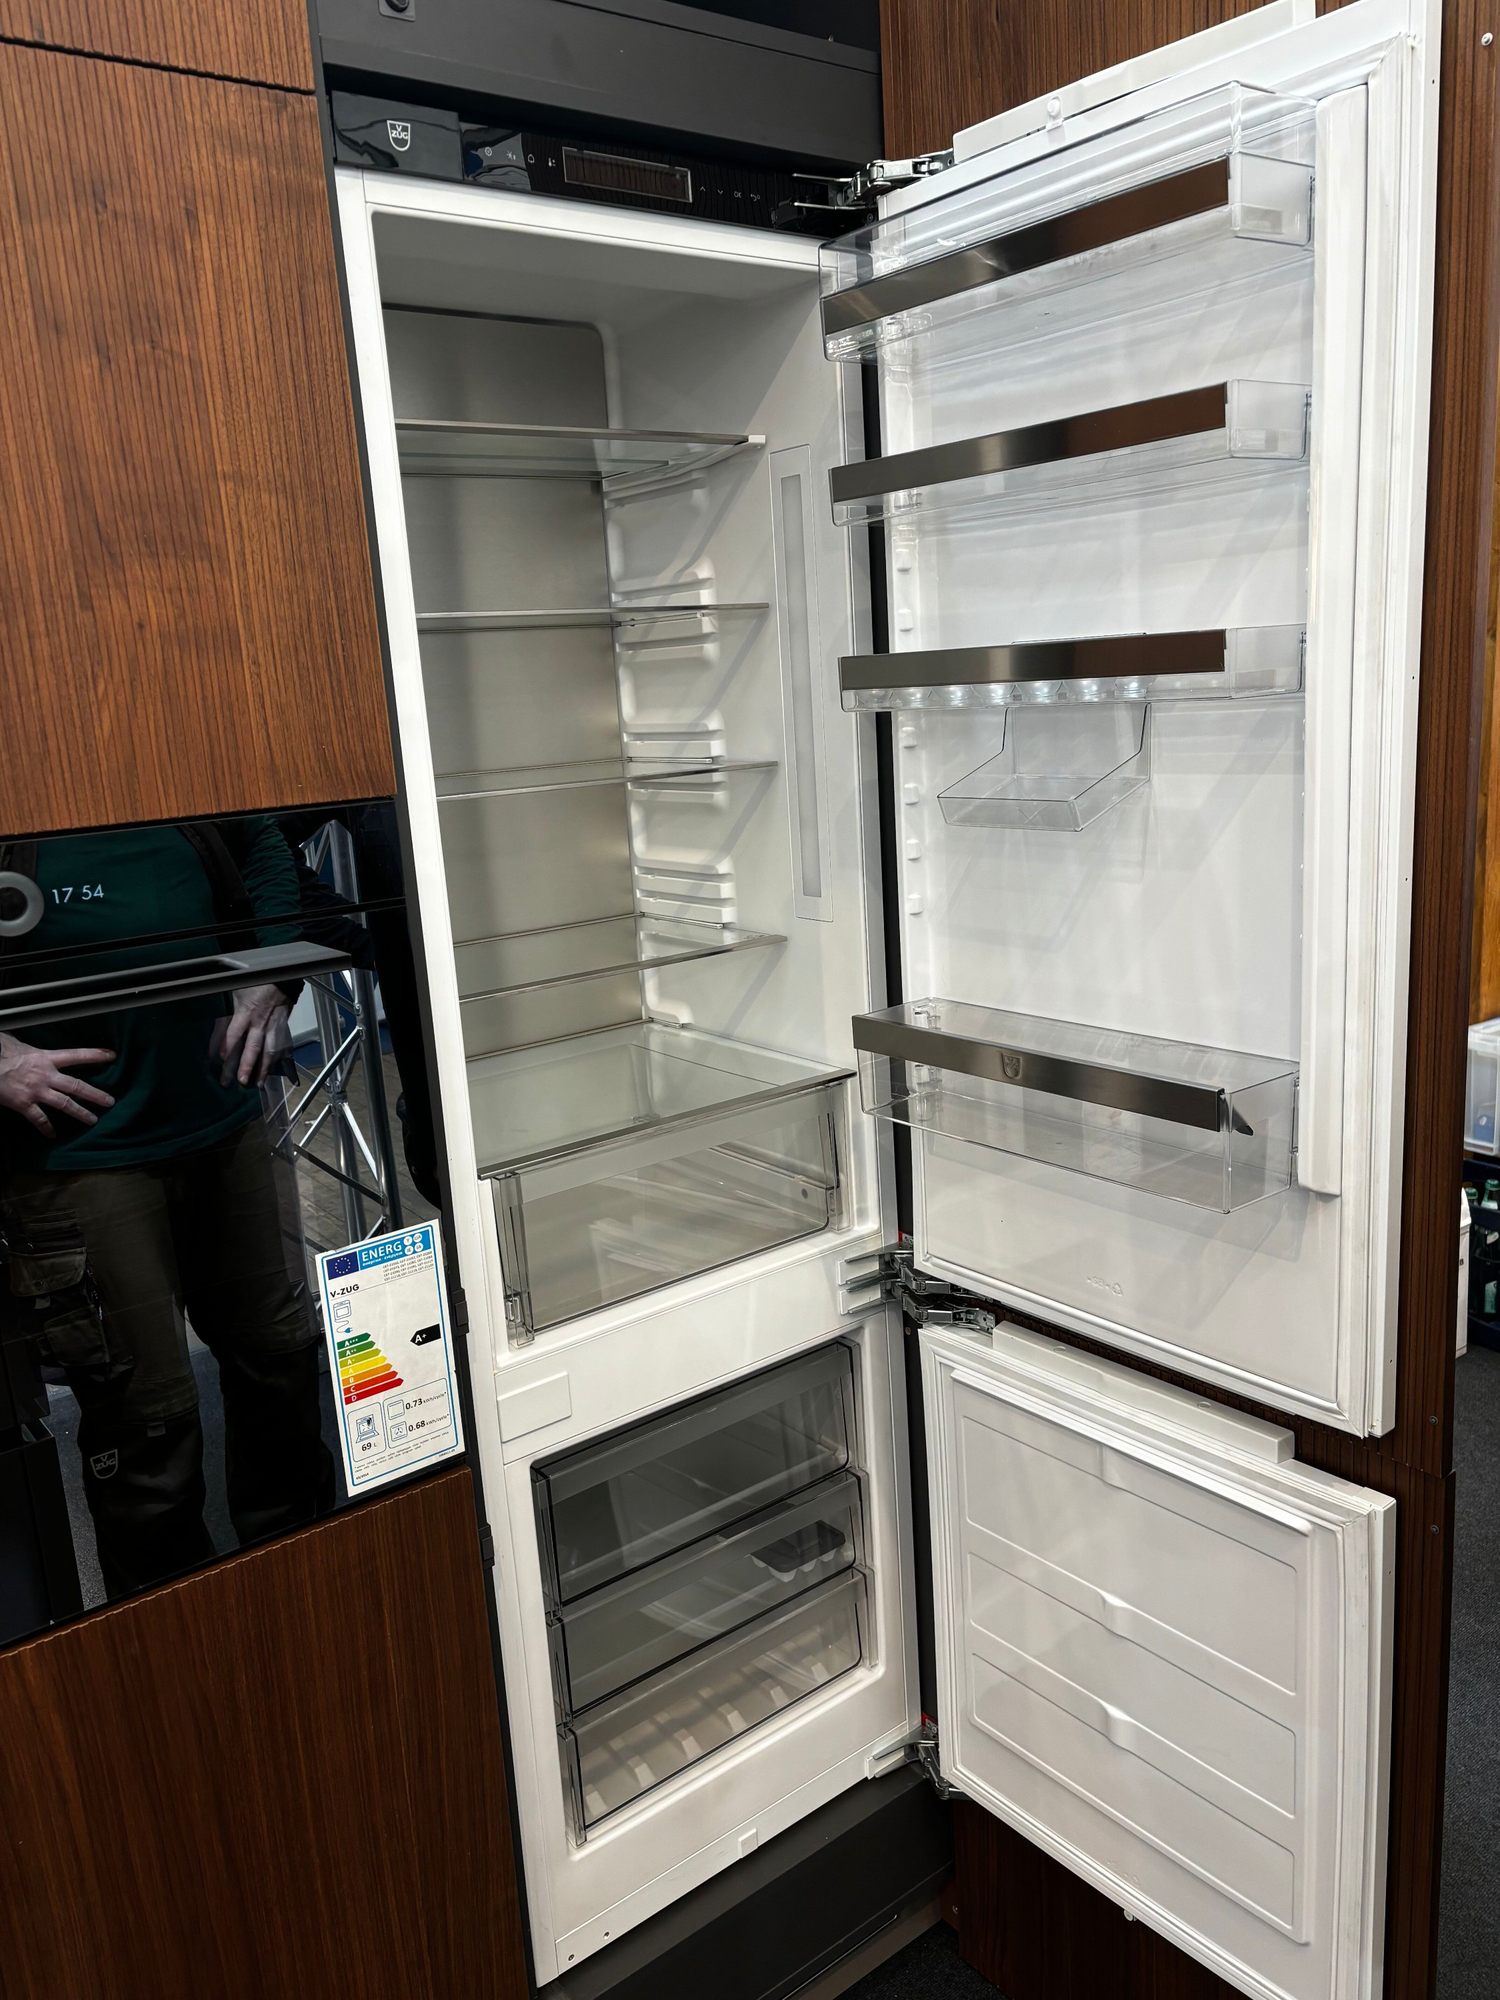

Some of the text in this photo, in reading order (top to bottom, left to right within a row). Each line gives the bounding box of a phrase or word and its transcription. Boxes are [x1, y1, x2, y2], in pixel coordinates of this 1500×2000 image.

[391, 129, 409, 140] ZUG
[52, 884, 104, 904] 17 54
[361, 1241, 402, 1262] ENERG
[330, 1284, 360, 1298] V-ZUG
[415, 1333, 427, 1343] A+
[405, 1398, 423, 1410] 0.73
[408, 1420, 426, 1432] 0.68
[361, 1442, 372, 1452] 69
